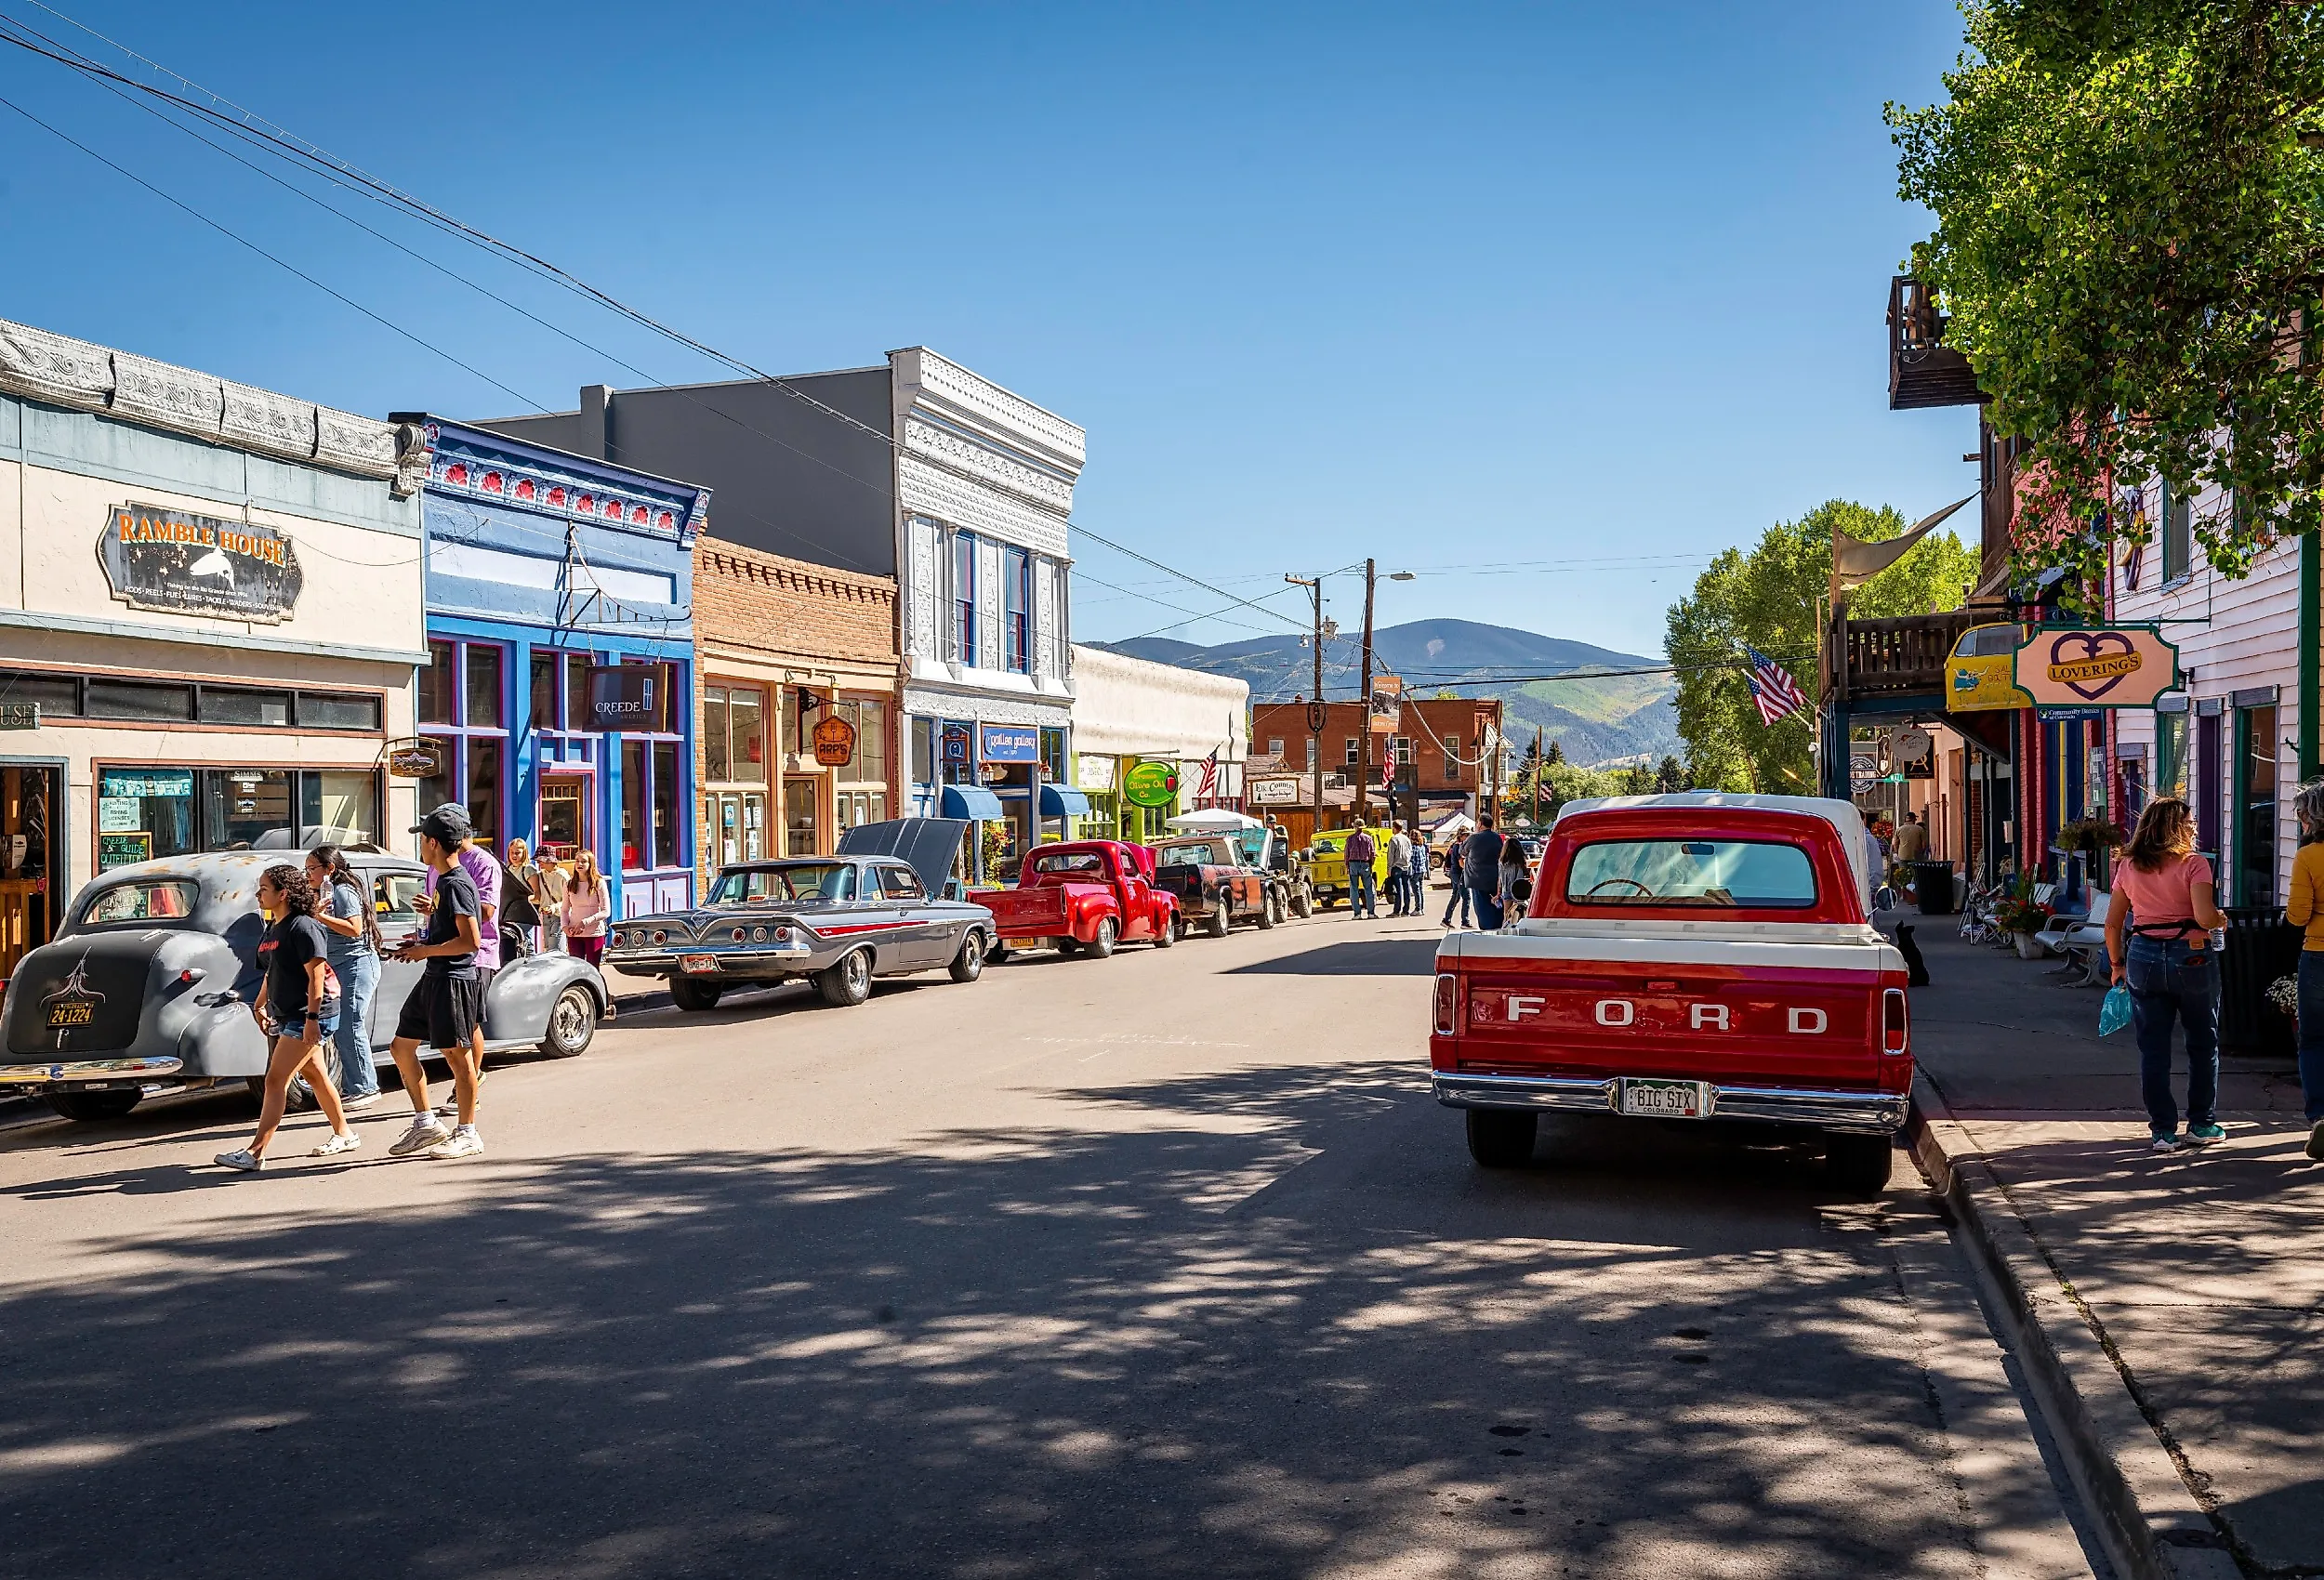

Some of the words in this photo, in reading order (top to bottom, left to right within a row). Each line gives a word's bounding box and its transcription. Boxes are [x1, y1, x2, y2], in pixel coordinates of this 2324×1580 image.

[119, 514, 216, 548] RAMBLE
[219, 531, 285, 568] HOUSE
[167, 582, 183, 590] Fishing
[208, 586, 225, 596] Grande
[125, 586, 142, 595] RODS
[145, 587, 164, 597] REELS
[165, 590, 182, 599] FLIES
[184, 593, 203, 602] LURES
[205, 595, 227, 605] TACKLE
[229, 599, 253, 608] WADERS
[2052, 655, 2139, 678] LOVERING'S
[595, 701, 640, 716] CREEDE
[2049, 708, 2081, 717] Community
[819, 743, 848, 755] ARP'S
[1855, 770, 1876, 779] TRADING
[1129, 781, 1151, 790] Olive
[1153, 780, 1165, 788] Oil
[1255, 783, 1267, 793] Elk
[1269, 782, 1294, 793] Country
[102, 836, 128, 845] CREEDE
[121, 844, 145, 854] GUIDE
[100, 853, 146, 865] OUTFITTERS
[1507, 996, 1828, 1034] FORD
[1637, 1089, 1662, 1107] BIG
[1667, 1090, 1691, 1109] SIX
